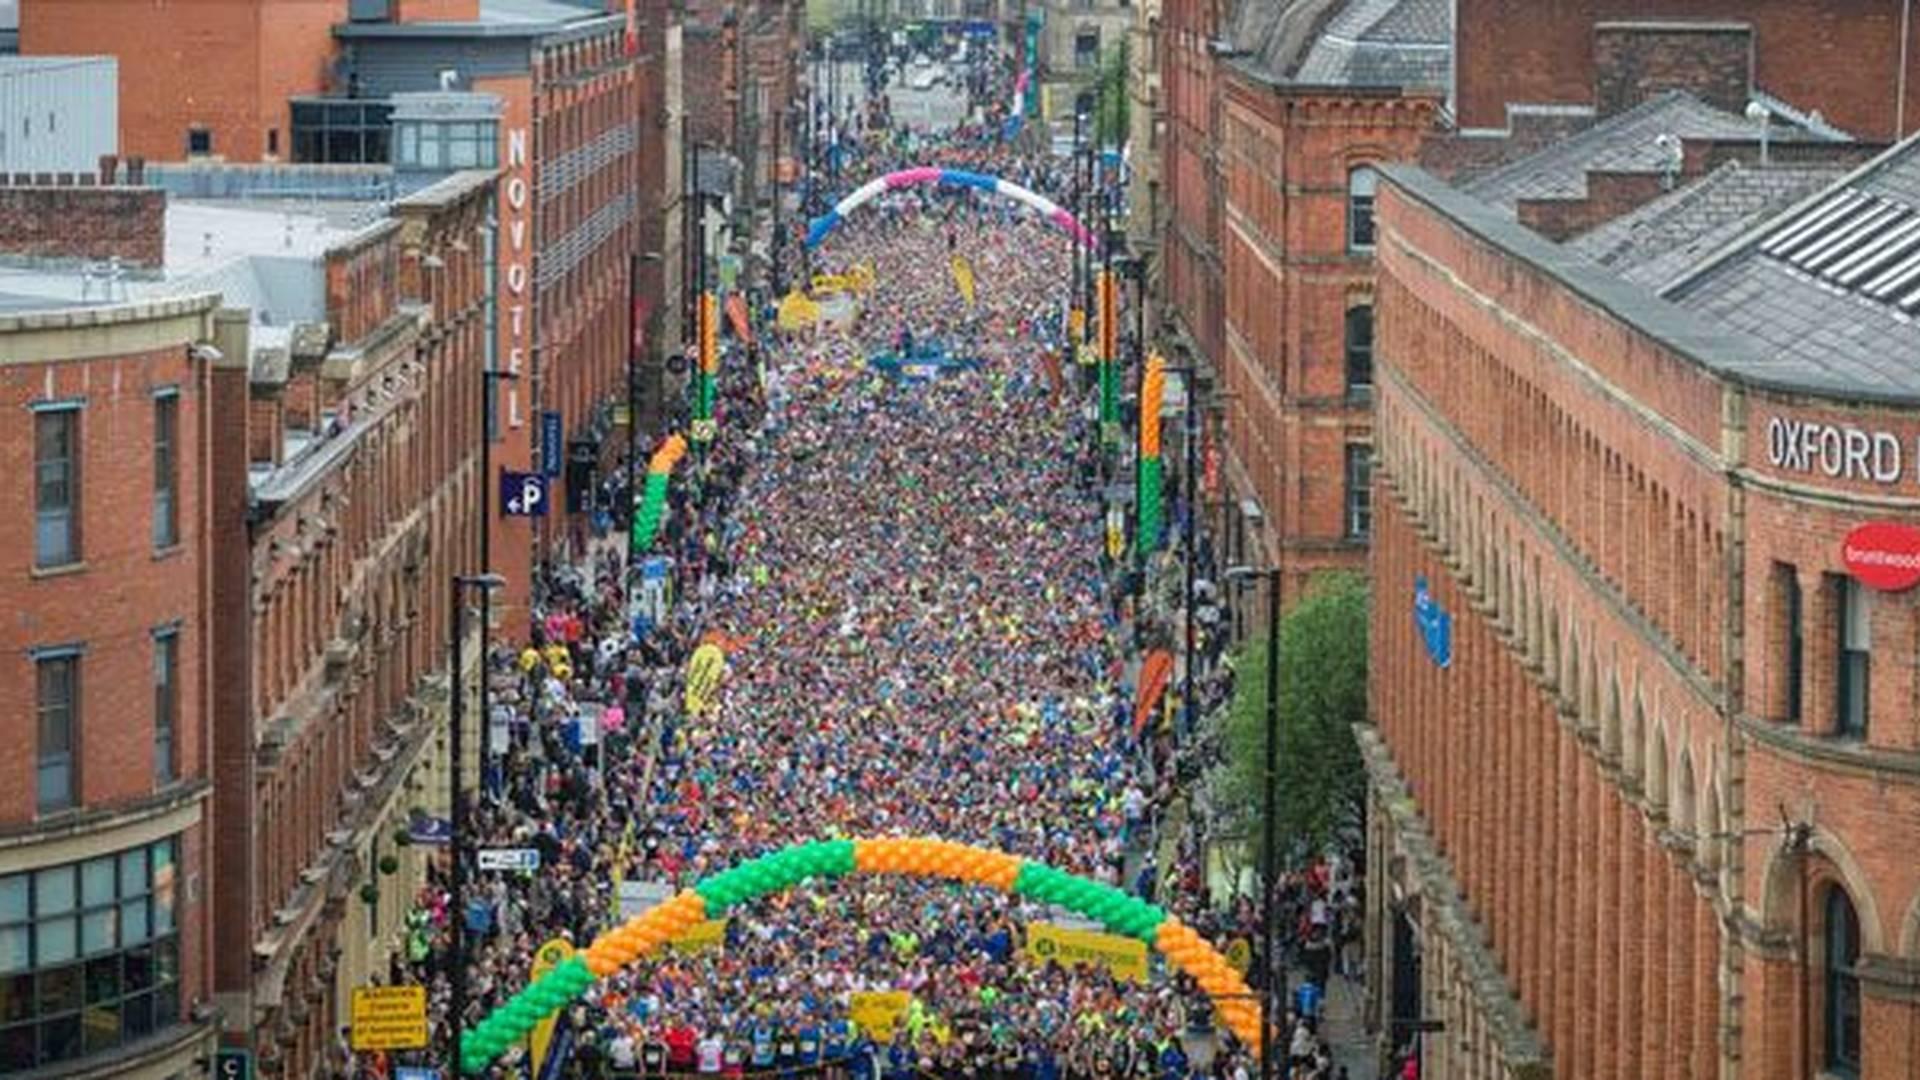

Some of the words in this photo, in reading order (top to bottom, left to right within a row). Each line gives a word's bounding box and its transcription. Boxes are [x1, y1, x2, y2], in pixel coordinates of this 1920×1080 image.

[508, 129, 526, 427] NOVOTEL
[1768, 415, 1901, 482] OXFORD
[523, 483, 541, 513] P
